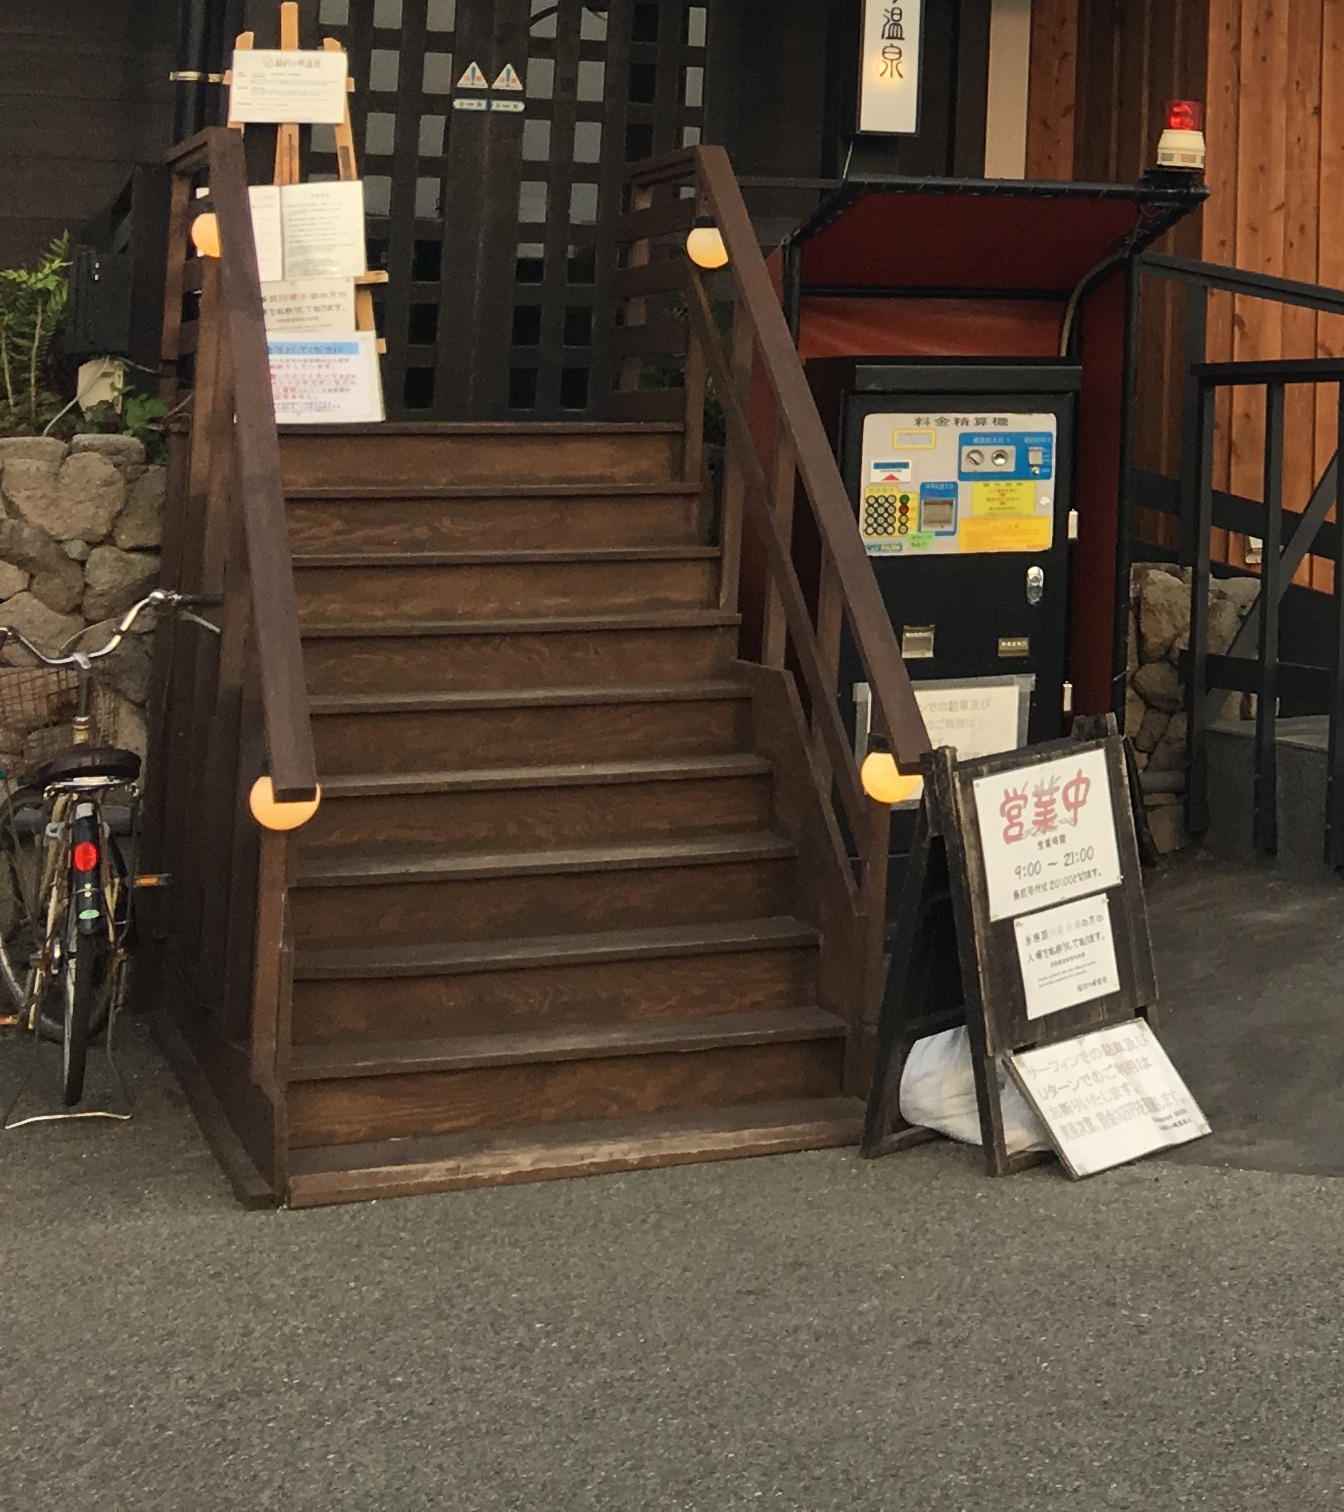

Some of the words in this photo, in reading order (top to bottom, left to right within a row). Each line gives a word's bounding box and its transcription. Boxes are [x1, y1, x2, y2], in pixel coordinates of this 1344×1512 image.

[914, 416, 1009, 428] 料金精算機
[999, 768, 1091, 845] 営業中
[1014, 860, 1042, 880] 9:00
[1063, 845, 1095, 868] 21:00
